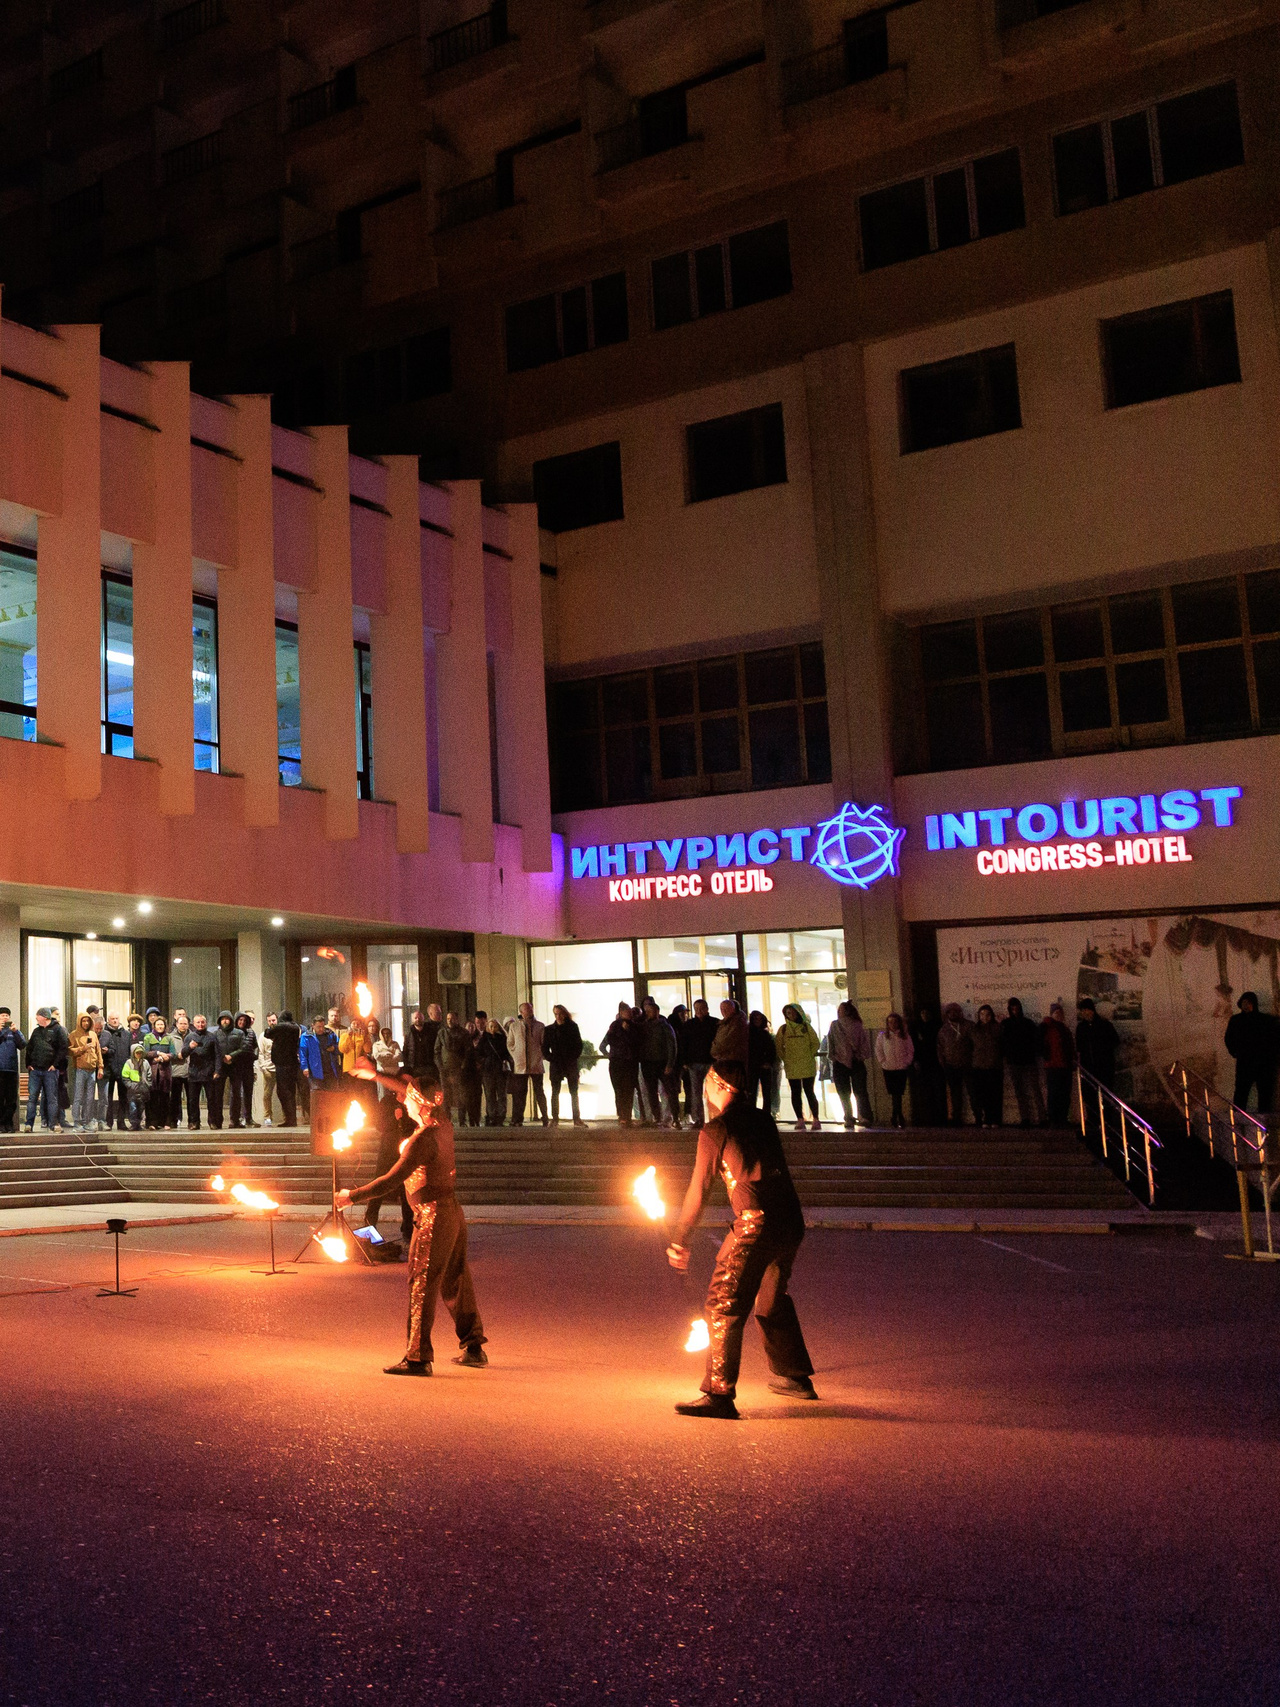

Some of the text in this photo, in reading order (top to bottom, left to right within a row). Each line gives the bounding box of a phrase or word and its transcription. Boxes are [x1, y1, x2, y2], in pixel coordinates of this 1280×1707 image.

[925, 786, 1242, 851] INTOURIST
[571, 826, 812, 879] ИНТУРИСТ
[977, 836, 1193, 875] CONGRESS-HOTEL
[609, 869, 774, 902] КОНГРЕСС ОТЕЛЬ
[949, 946, 1061, 967] «Интурист»
